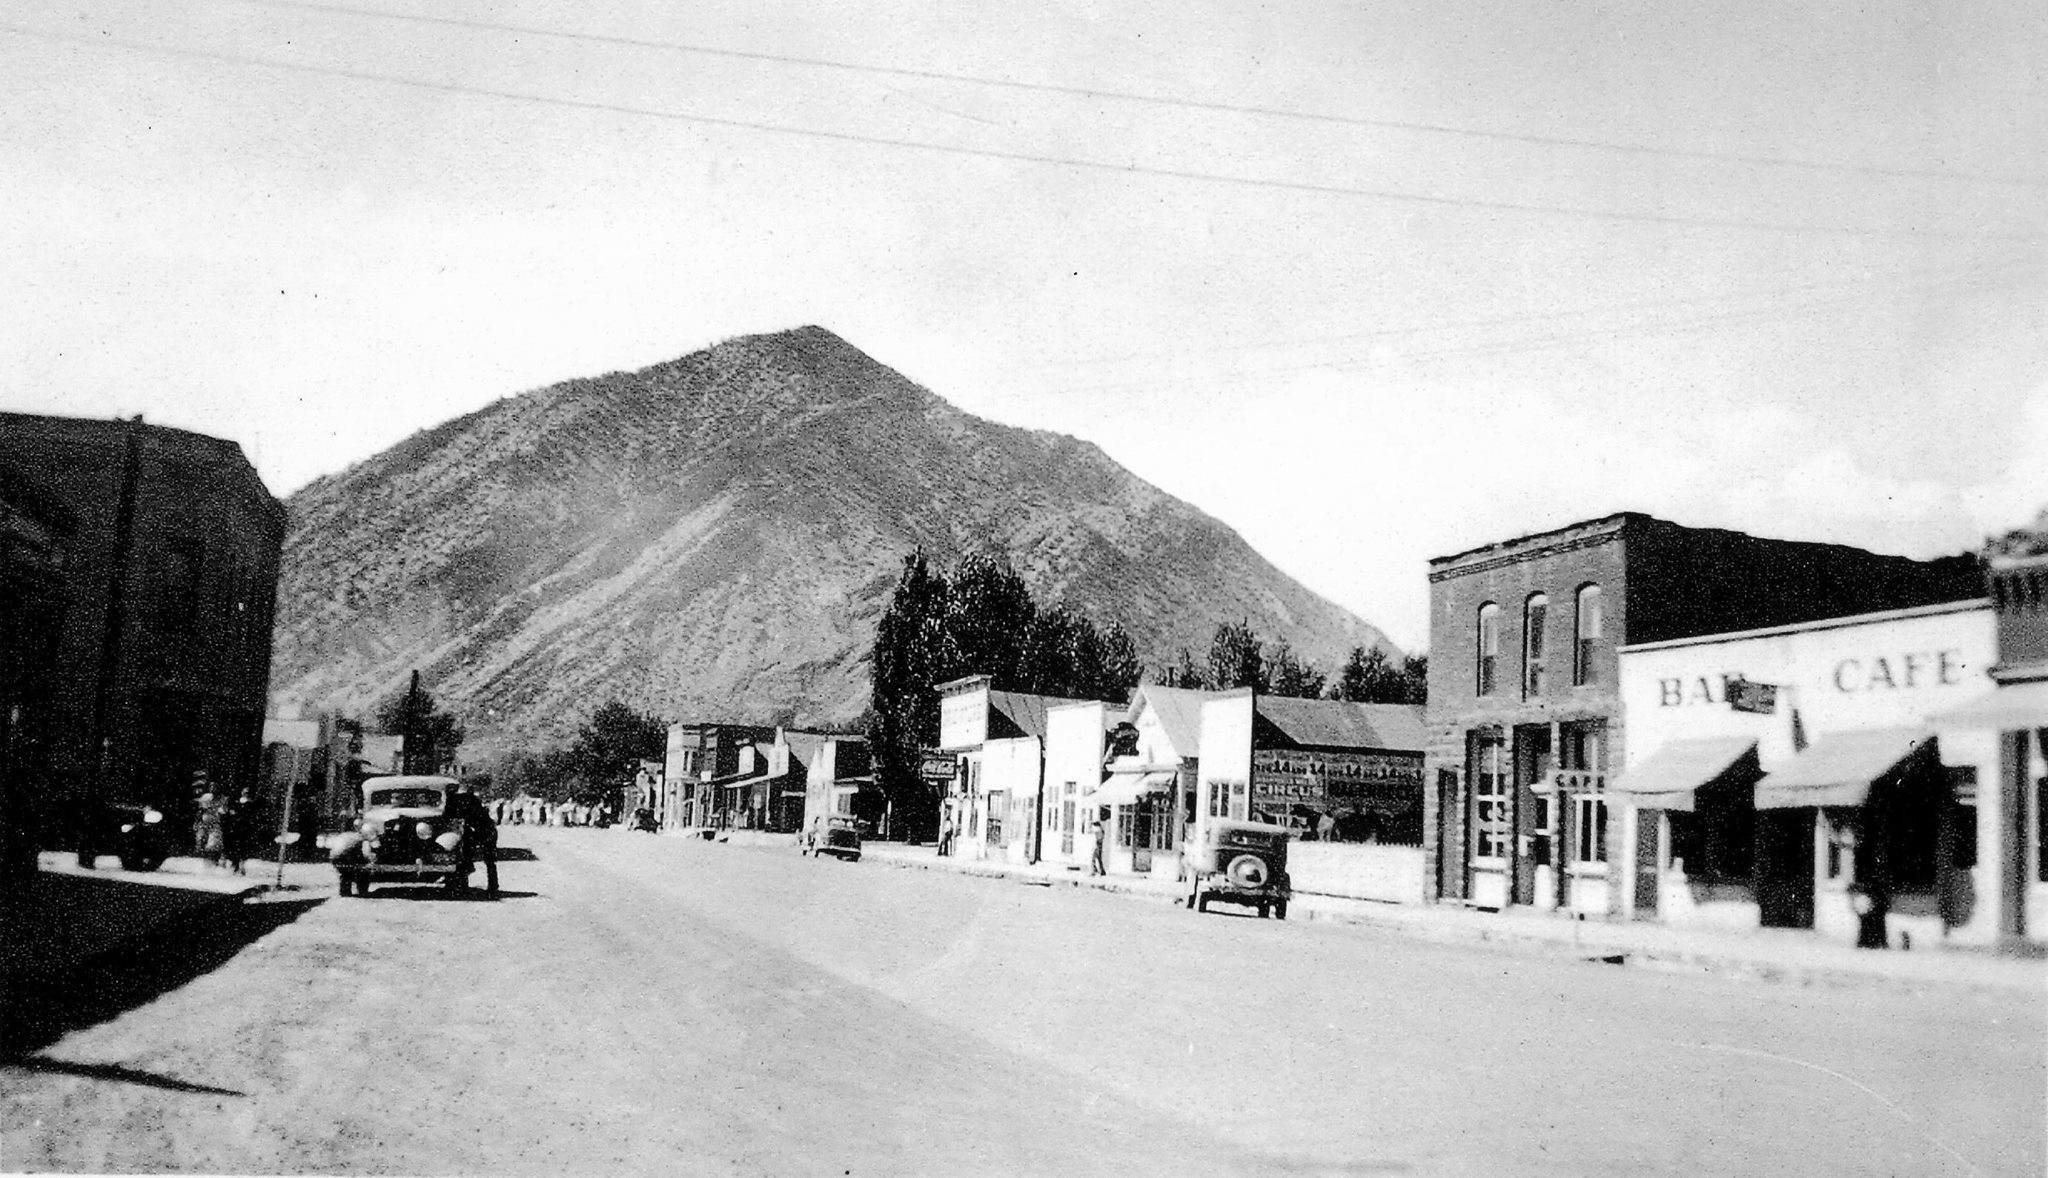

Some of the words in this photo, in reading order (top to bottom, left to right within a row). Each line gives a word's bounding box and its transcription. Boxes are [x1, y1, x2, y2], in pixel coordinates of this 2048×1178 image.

[1833, 649, 1961, 692] CAFE
[1555, 773, 1605, 788] CAFE
[1255, 783, 1324, 797] CIRCUS
